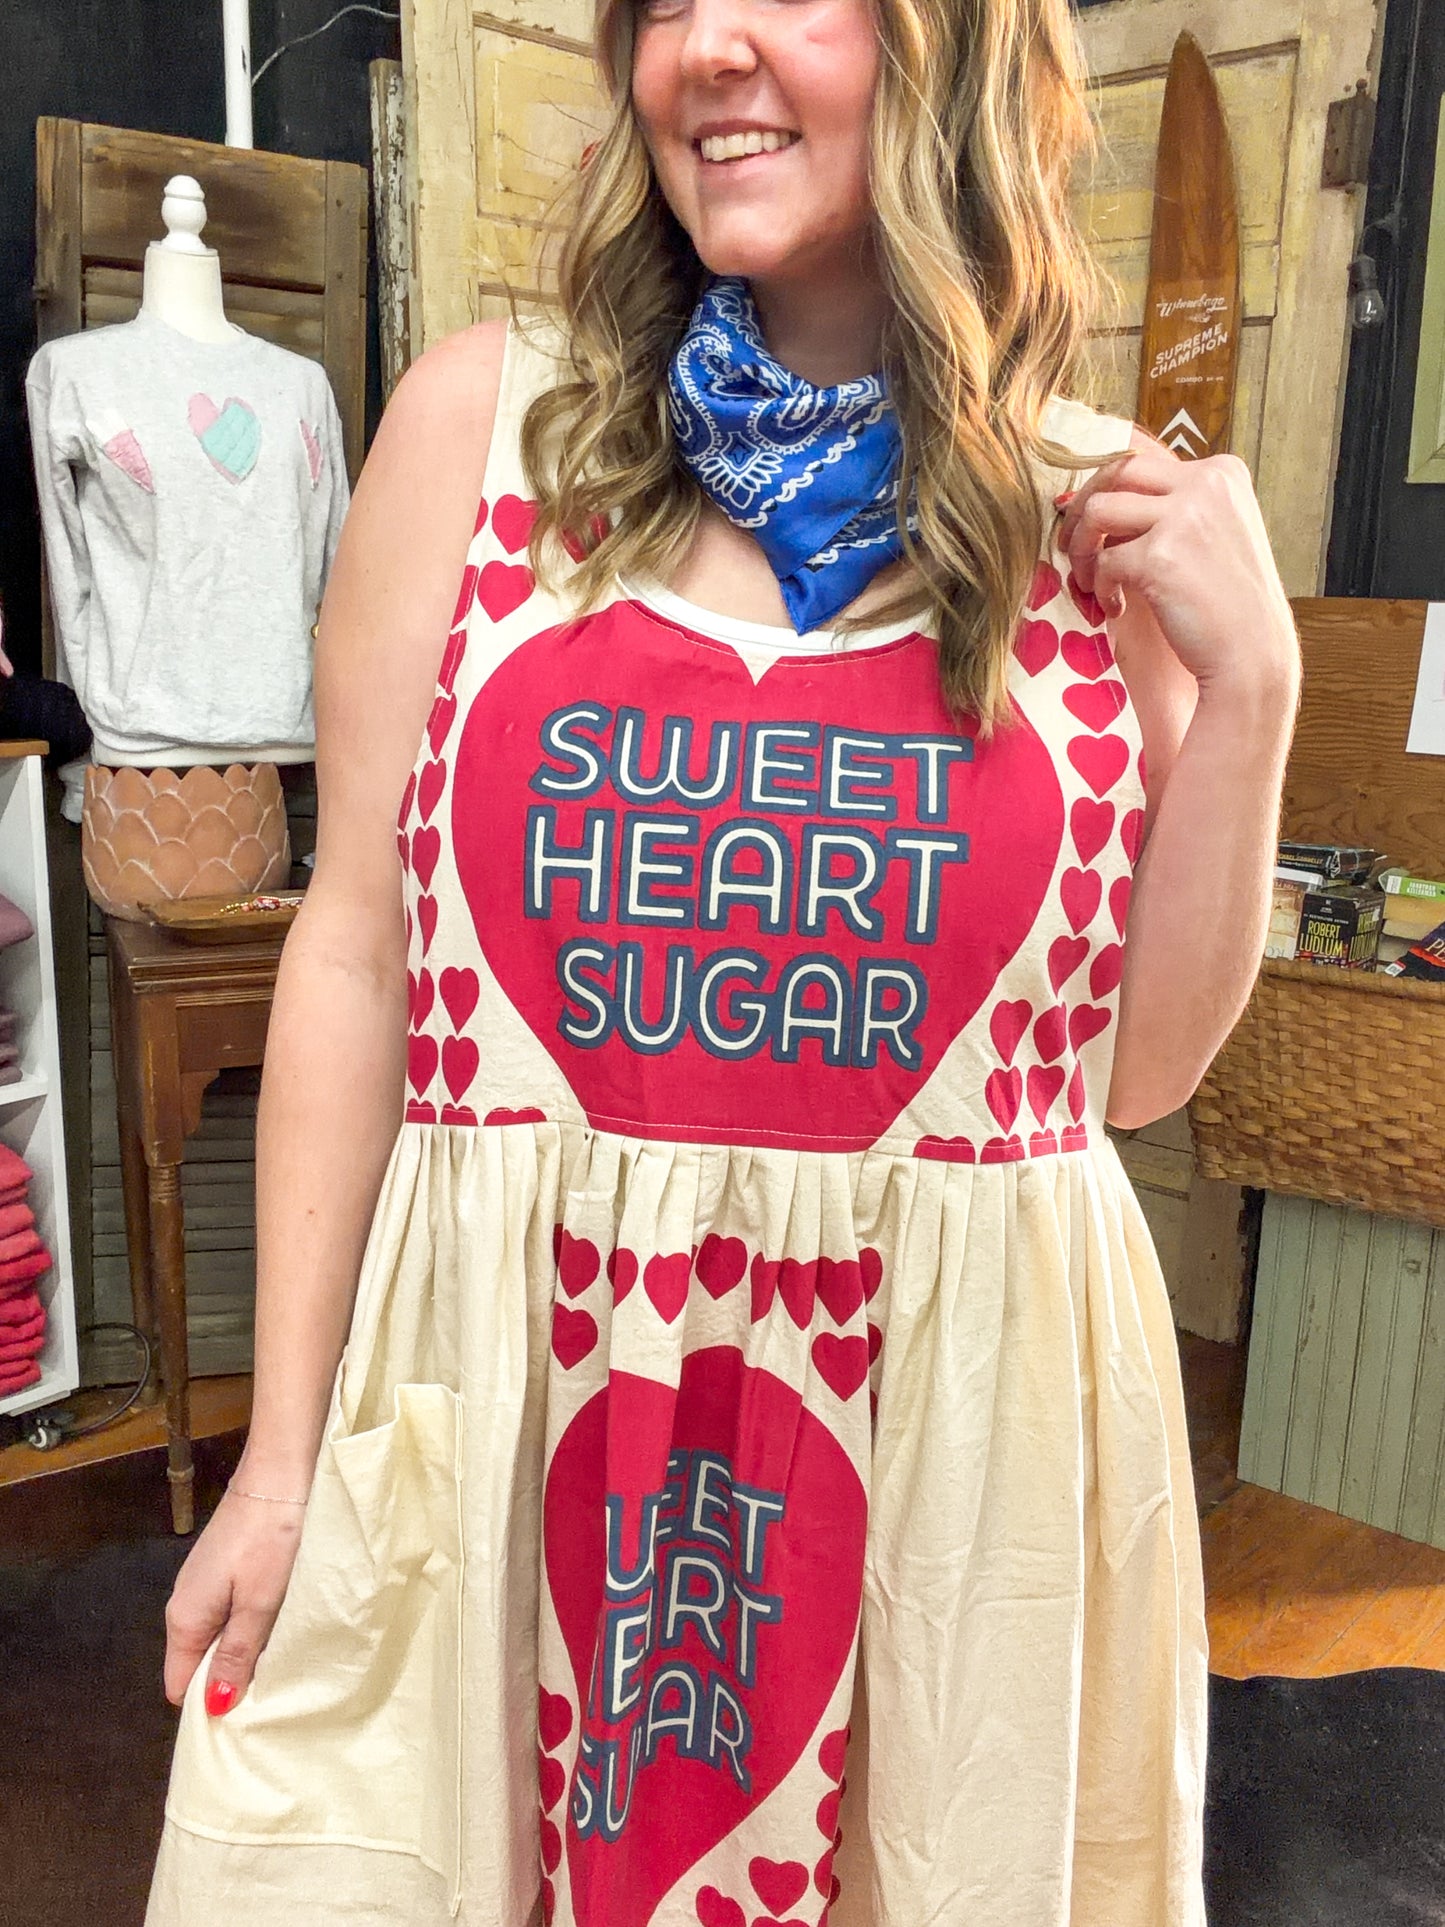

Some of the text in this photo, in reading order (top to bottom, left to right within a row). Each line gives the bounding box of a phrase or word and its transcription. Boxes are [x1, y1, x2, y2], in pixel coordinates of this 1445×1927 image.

[1150, 331, 1228, 379] CHAMPION
[1156, 322, 1223, 365] SUPREME
[529, 700, 974, 823] SWEET
[524, 805, 969, 944] HEART
[1300, 932, 1343, 959] LUDLUM
[1307, 920, 1341, 939] ROBERT
[557, 937, 929, 1071] SUGAR
[571, 1661, 753, 1842] SUAR
